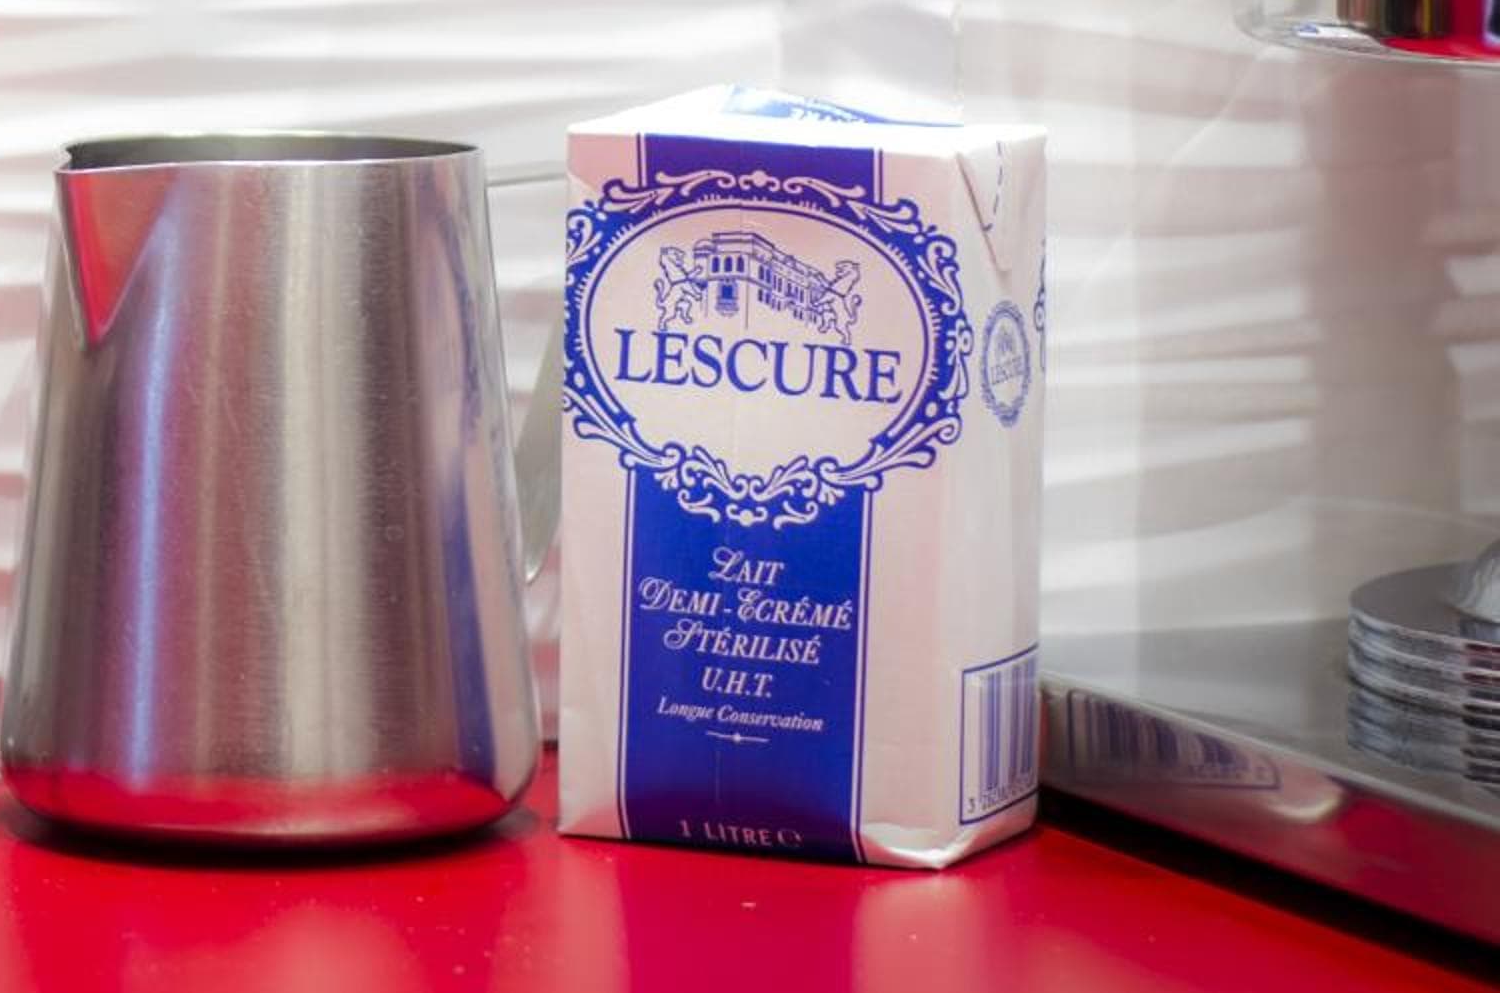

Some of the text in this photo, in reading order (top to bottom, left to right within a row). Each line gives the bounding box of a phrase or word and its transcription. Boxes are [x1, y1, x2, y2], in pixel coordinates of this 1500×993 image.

[613, 328, 901, 404] LESCURE
[708, 547, 784, 586] LAIT
[663, 618, 822, 665] STÉRILISÉ
[701, 666, 773, 698] U.H.T.
[657, 696, 824, 732] Longue Conservation
[679, 819, 692, 838] 1
[703, 821, 772, 847] LITRE
